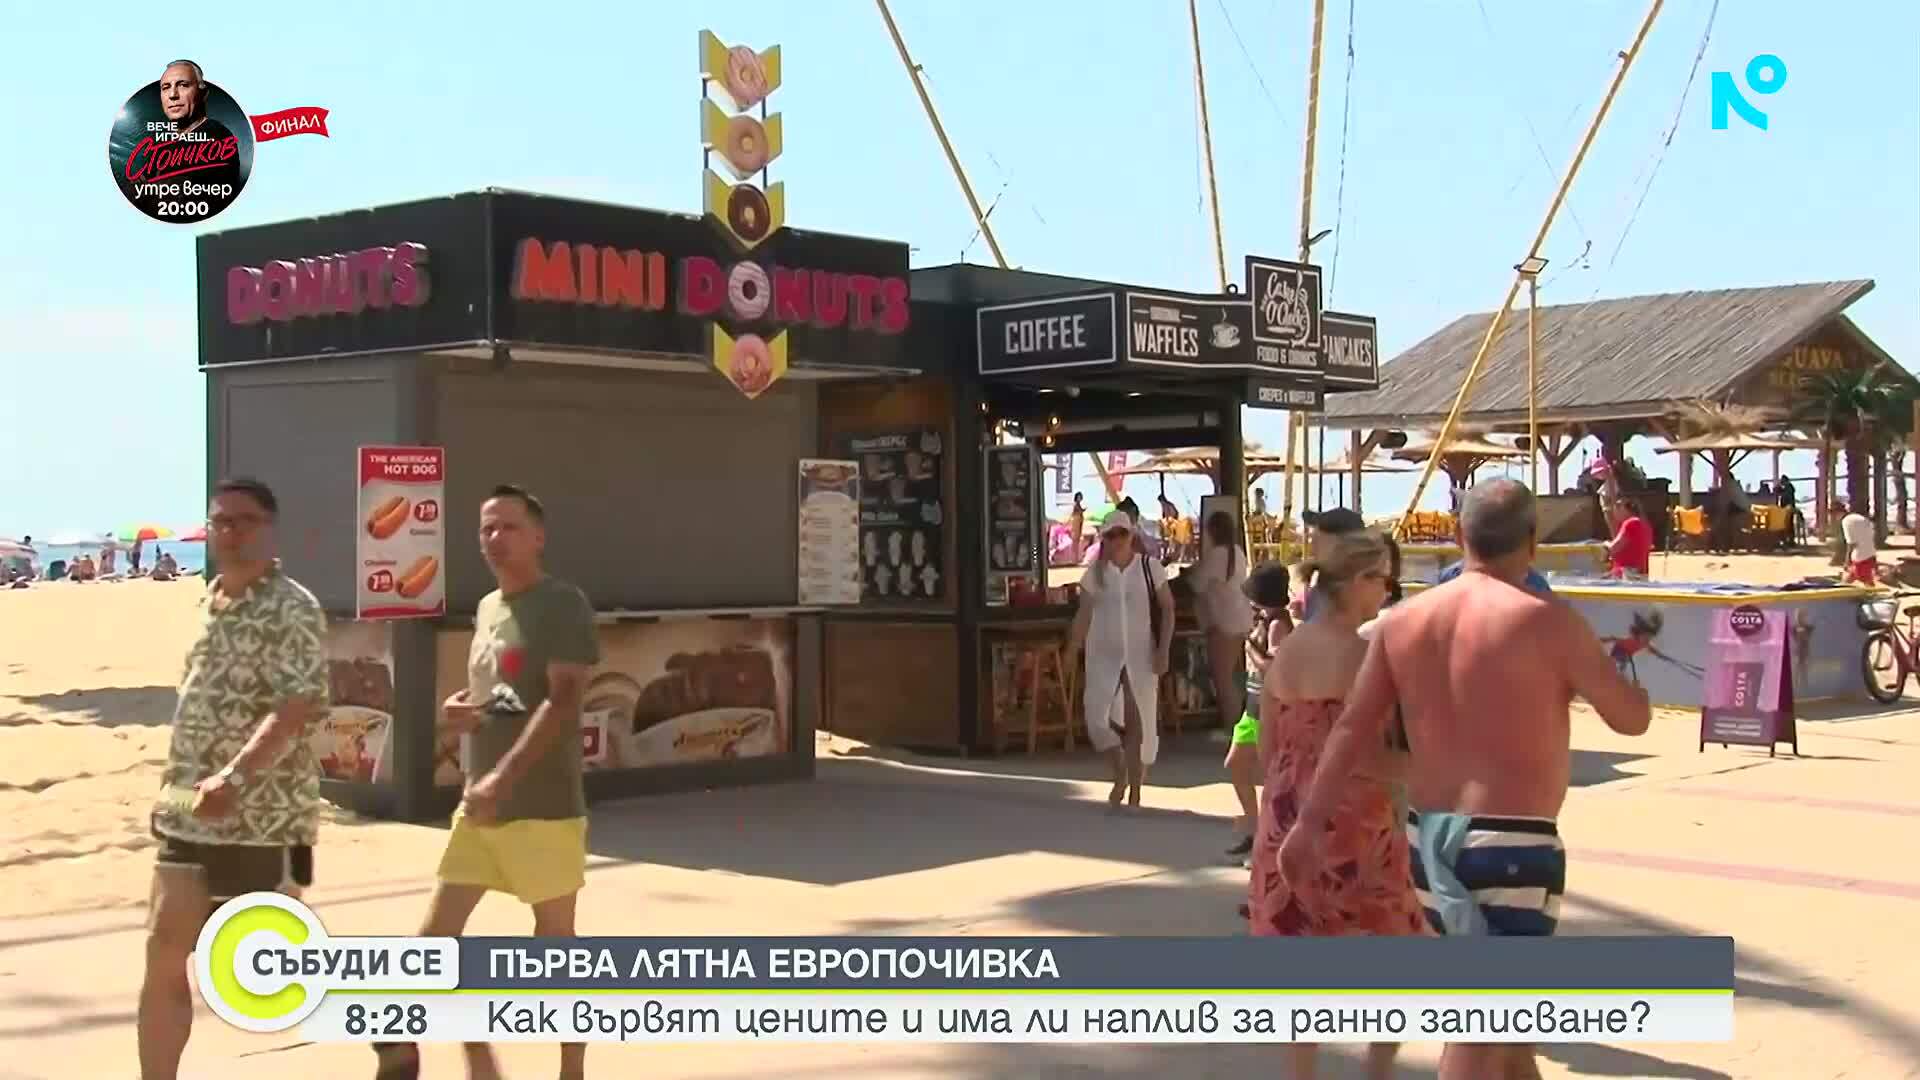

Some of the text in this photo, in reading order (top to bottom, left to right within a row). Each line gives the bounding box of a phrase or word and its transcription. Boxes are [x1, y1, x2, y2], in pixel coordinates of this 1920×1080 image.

[227, 241, 431, 325] DONUTS
[514, 237, 909, 335] MINI DONUTS
[1005, 314, 1087, 354] COFFEE
[1133, 321, 1199, 357] WAFFLES
[384, 464, 437, 475] HOT DOG
[1731, 616, 1762, 624] COSTA
[1735, 671, 1747, 707] COSTA
